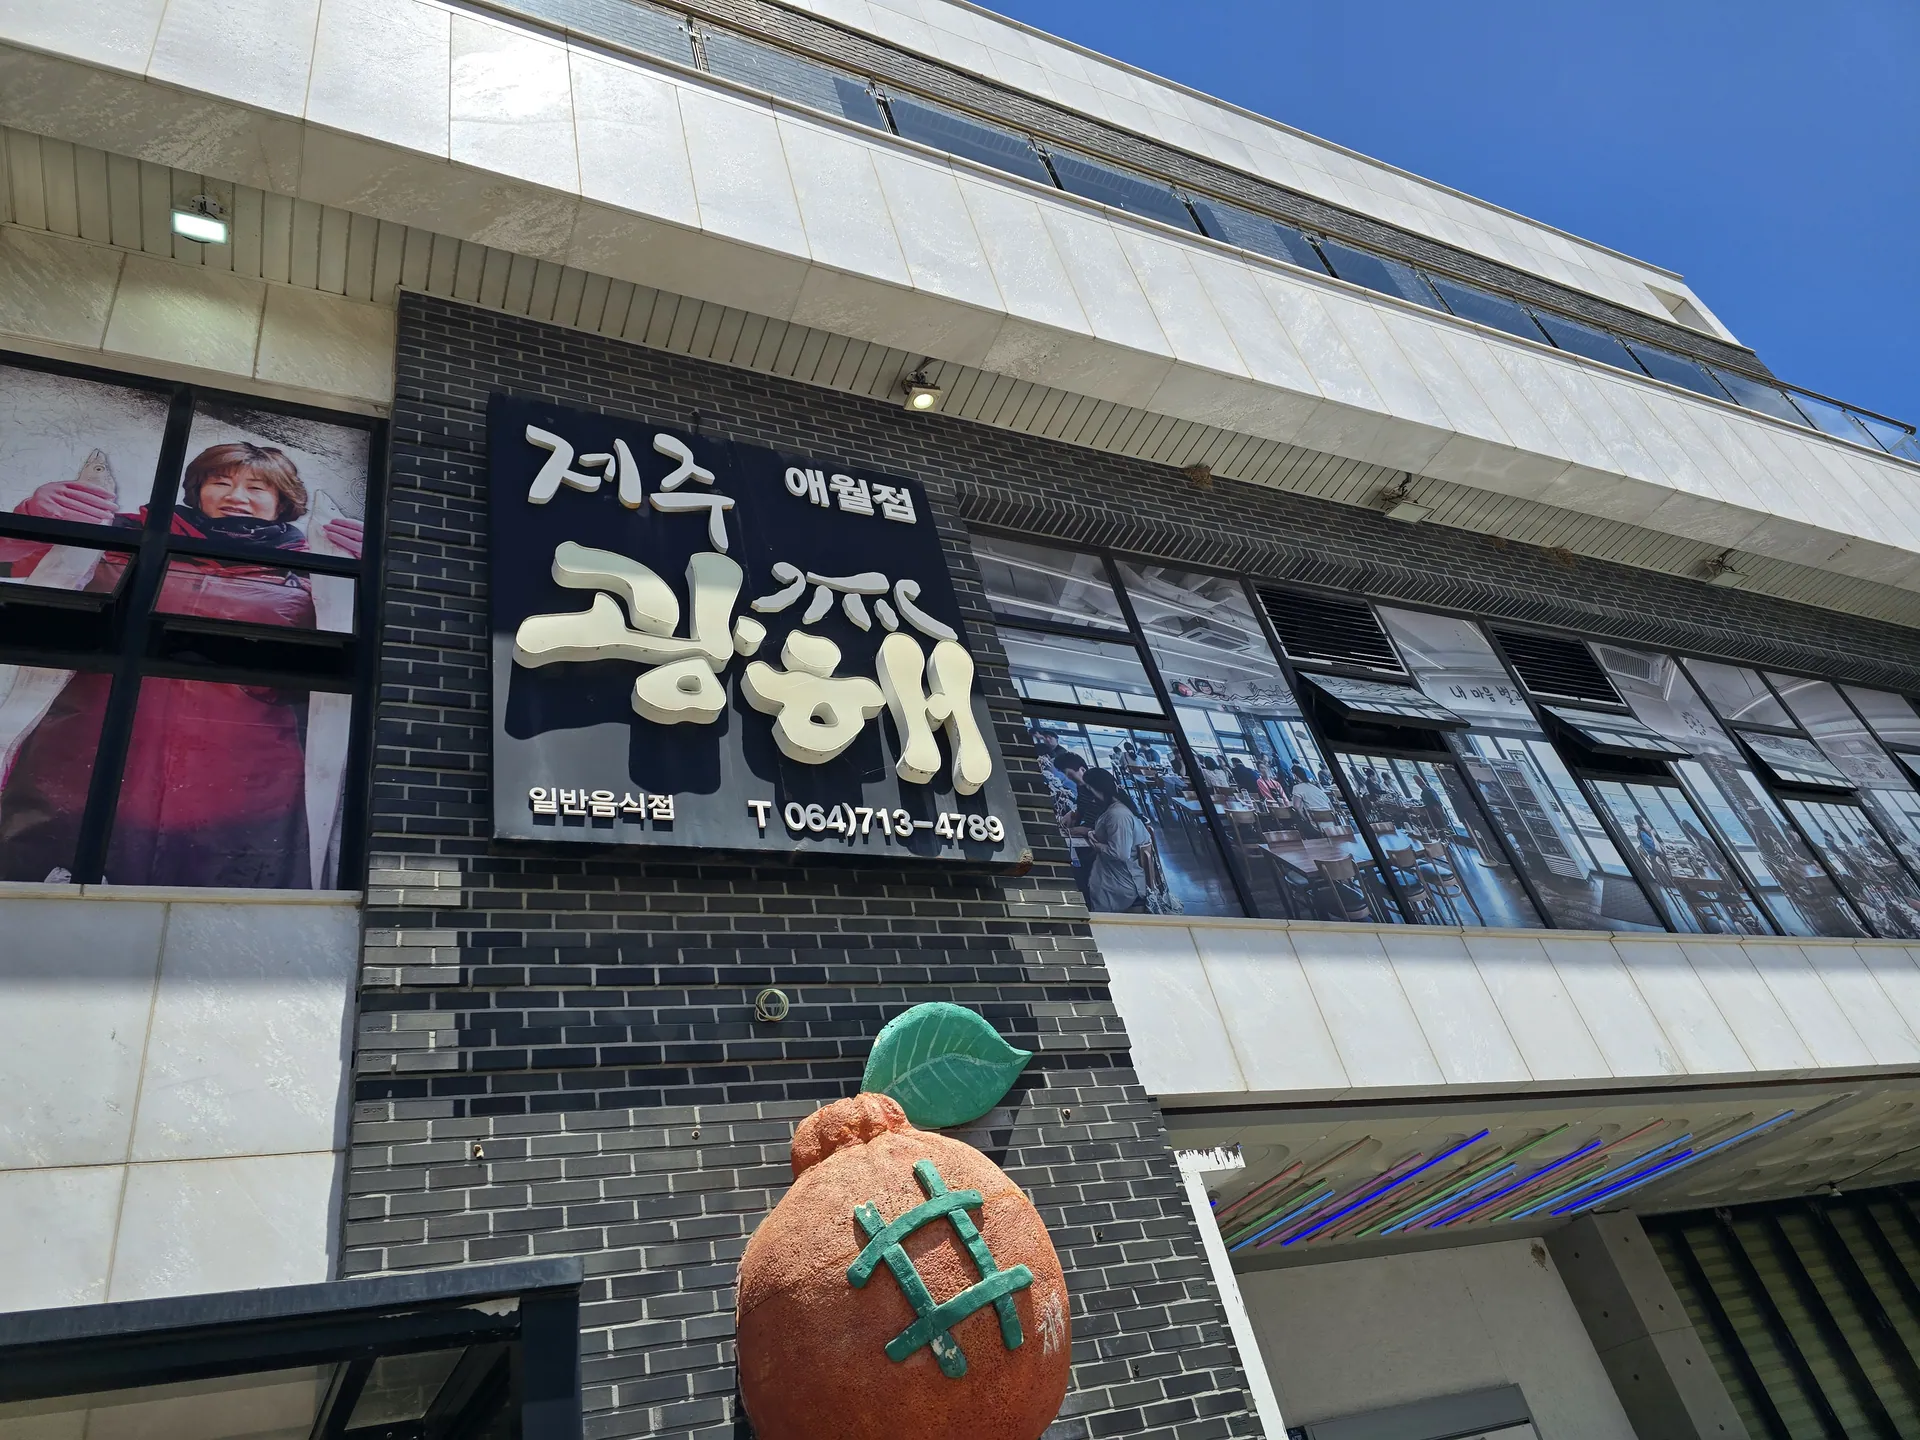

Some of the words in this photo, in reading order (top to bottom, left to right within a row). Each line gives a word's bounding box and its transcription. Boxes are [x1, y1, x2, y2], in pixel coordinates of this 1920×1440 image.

[526, 424, 735, 554] 제주
[784, 466, 918, 525] 애월점
[513, 540, 993, 796] 광해
[1469, 686, 1496, 703] 마음
[528, 786, 676, 821] 일반음식점
[747, 799, 772, 829] T
[784, 802, 1006, 842] 064)713-4789
